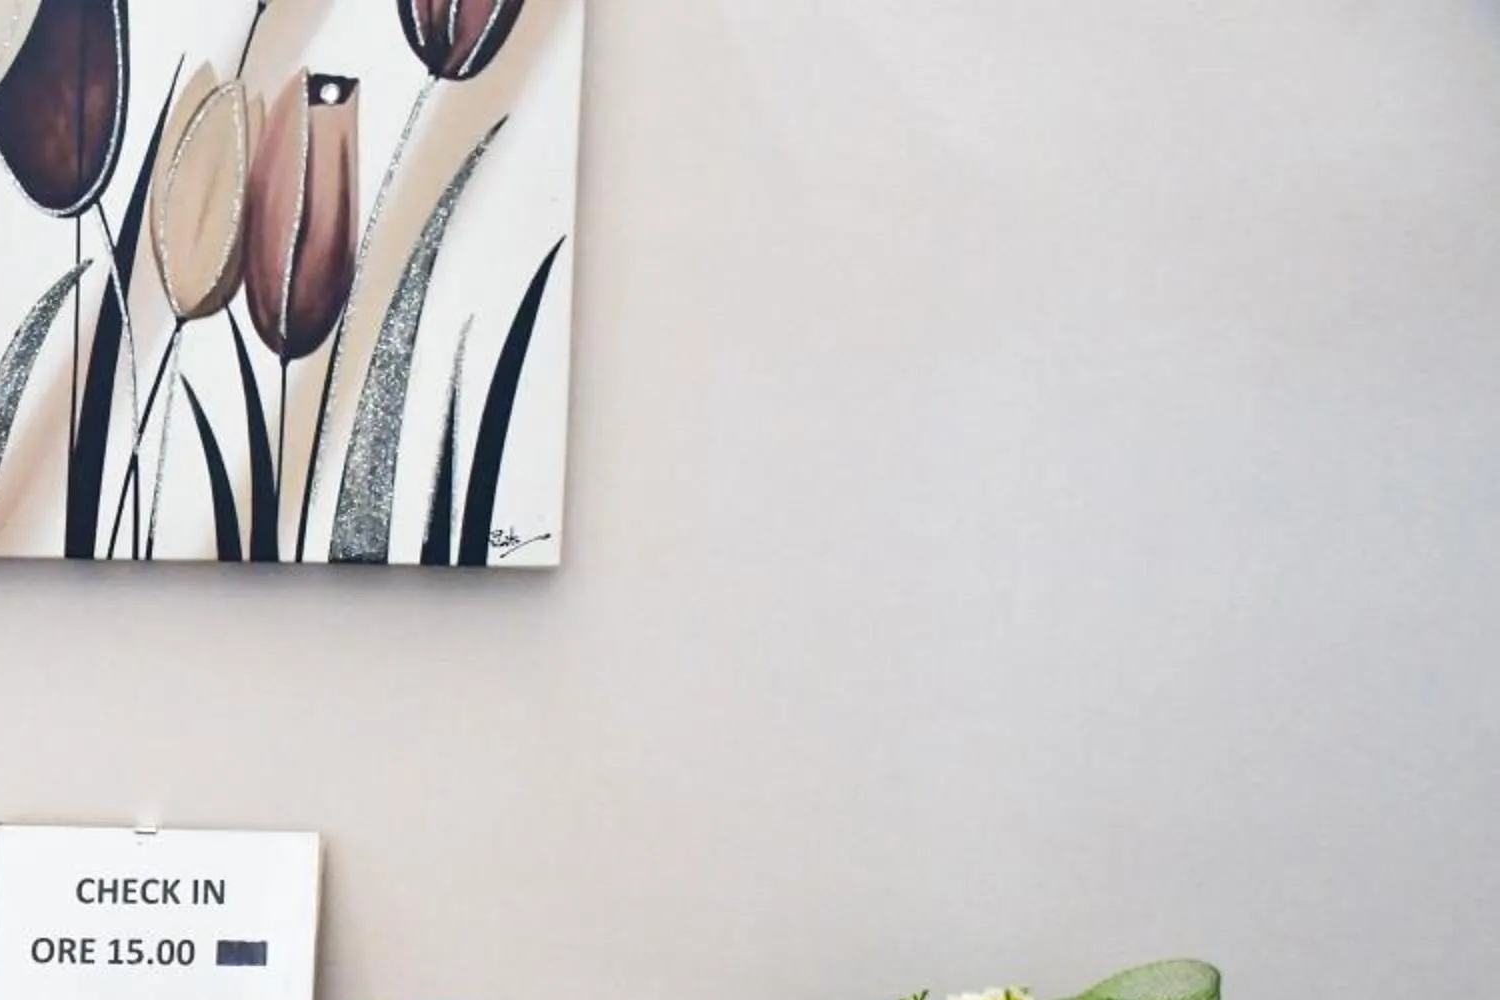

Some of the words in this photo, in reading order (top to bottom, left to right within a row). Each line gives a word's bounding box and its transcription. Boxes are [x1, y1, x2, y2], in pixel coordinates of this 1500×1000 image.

[76, 878, 181, 905] CHECK
[192, 880, 226, 905] IN
[30, 937, 96, 965] ORE
[107, 939, 196, 966] 15.00
